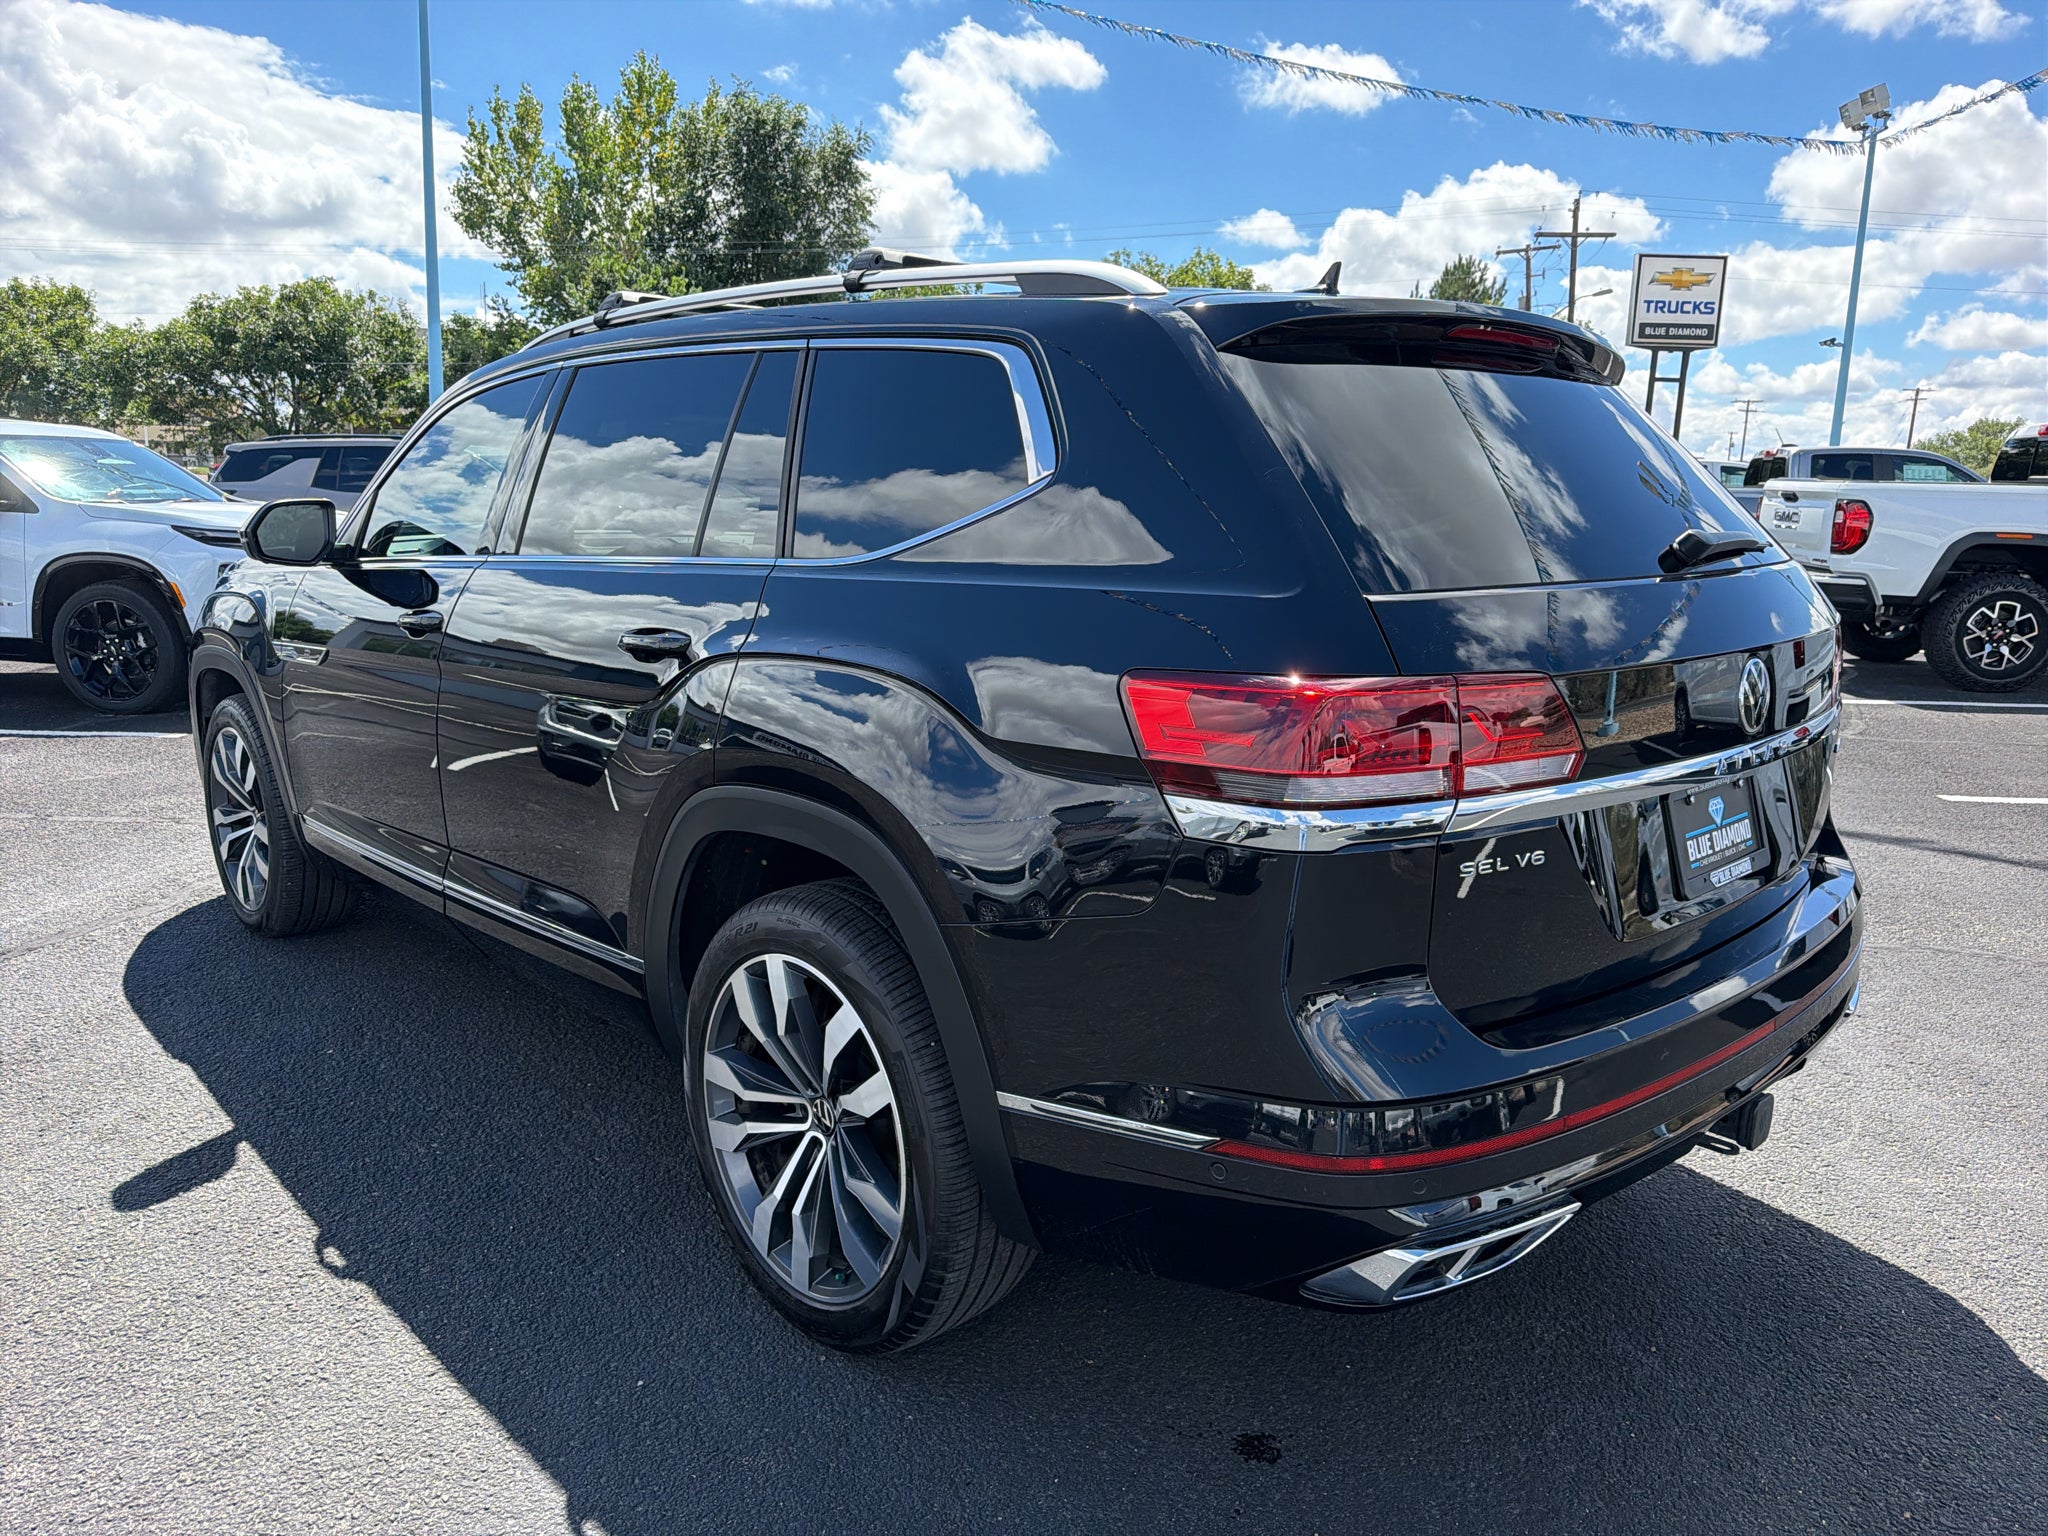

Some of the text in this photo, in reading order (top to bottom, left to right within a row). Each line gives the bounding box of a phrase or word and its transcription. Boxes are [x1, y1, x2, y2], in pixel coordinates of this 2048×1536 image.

[1644, 300, 1716, 315] TRUCKS
[1645, 327, 1709, 337] BLUE DIAMOND
[1774, 511, 1800, 524] GMC
[1714, 741, 1788, 776] ATLAS
[1686, 818, 1752, 862] BLUE DIAMOND
[1460, 850, 1546, 877] SEL V6
[1700, 852, 1724, 867] CHEVROLET
[1718, 868, 1731, 882] BLUE
